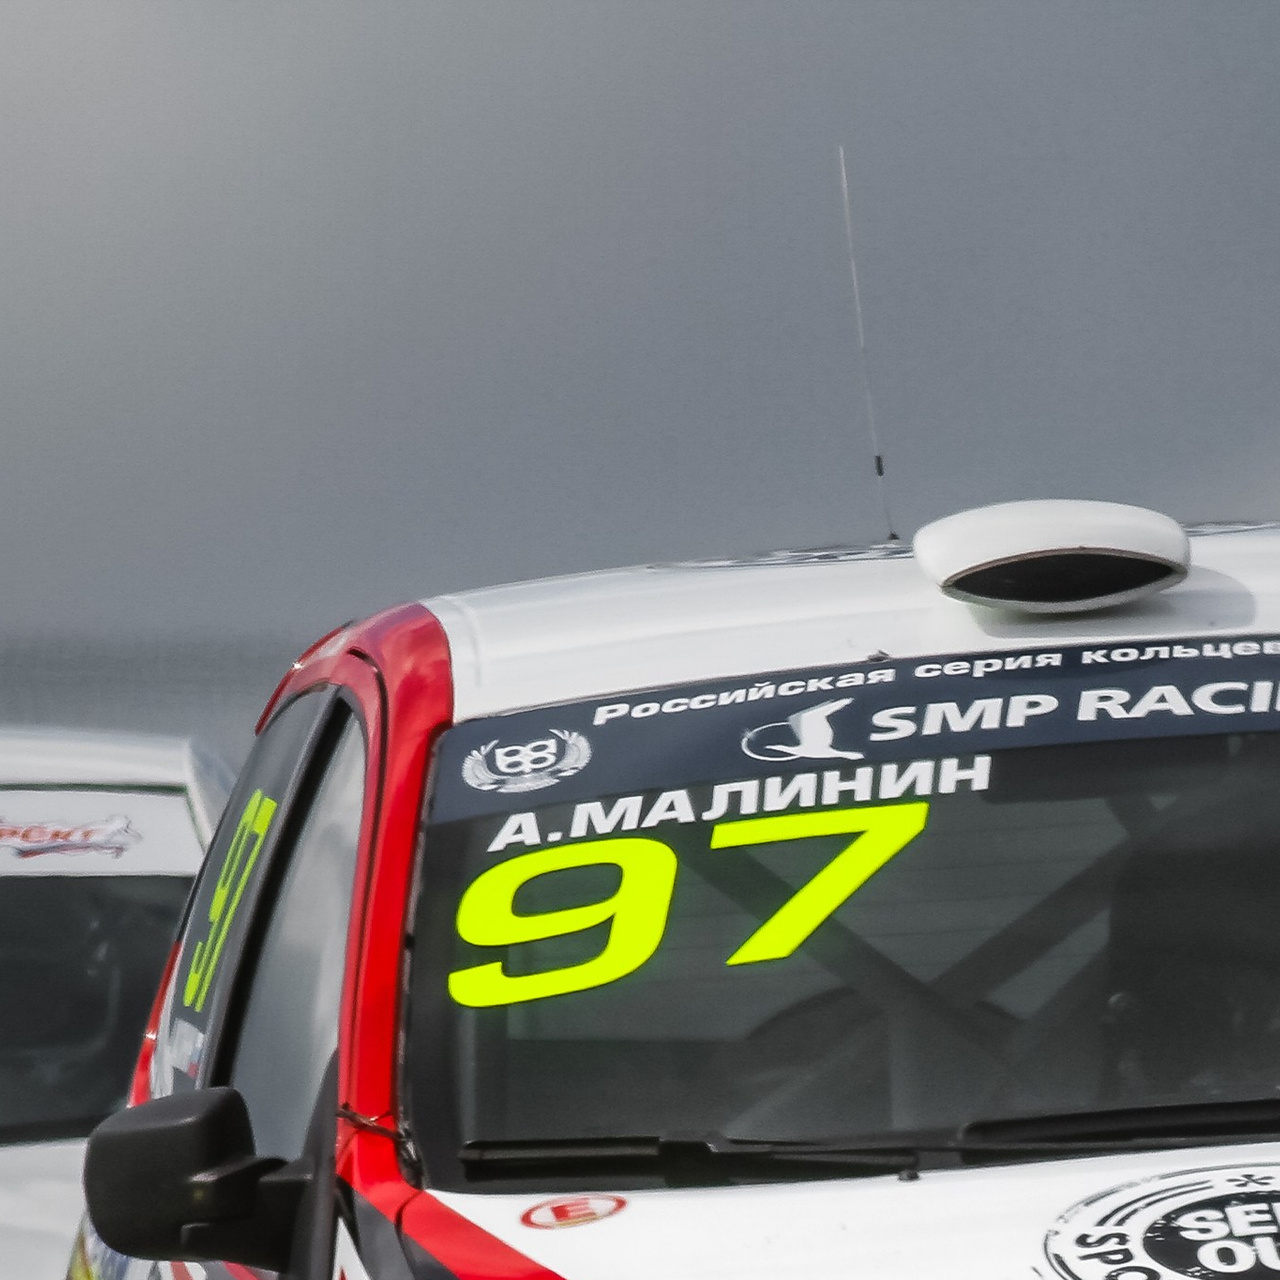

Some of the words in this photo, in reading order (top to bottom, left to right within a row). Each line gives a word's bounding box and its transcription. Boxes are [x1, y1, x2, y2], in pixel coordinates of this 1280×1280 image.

[592, 667, 897, 725] Российская
[914, 652, 1062, 679] серия
[869, 694, 1059, 742] SMP
[486, 755, 993, 853] А.МАЛИНИН
[182, 788, 278, 1013] 97
[448, 801, 930, 1009] 97
